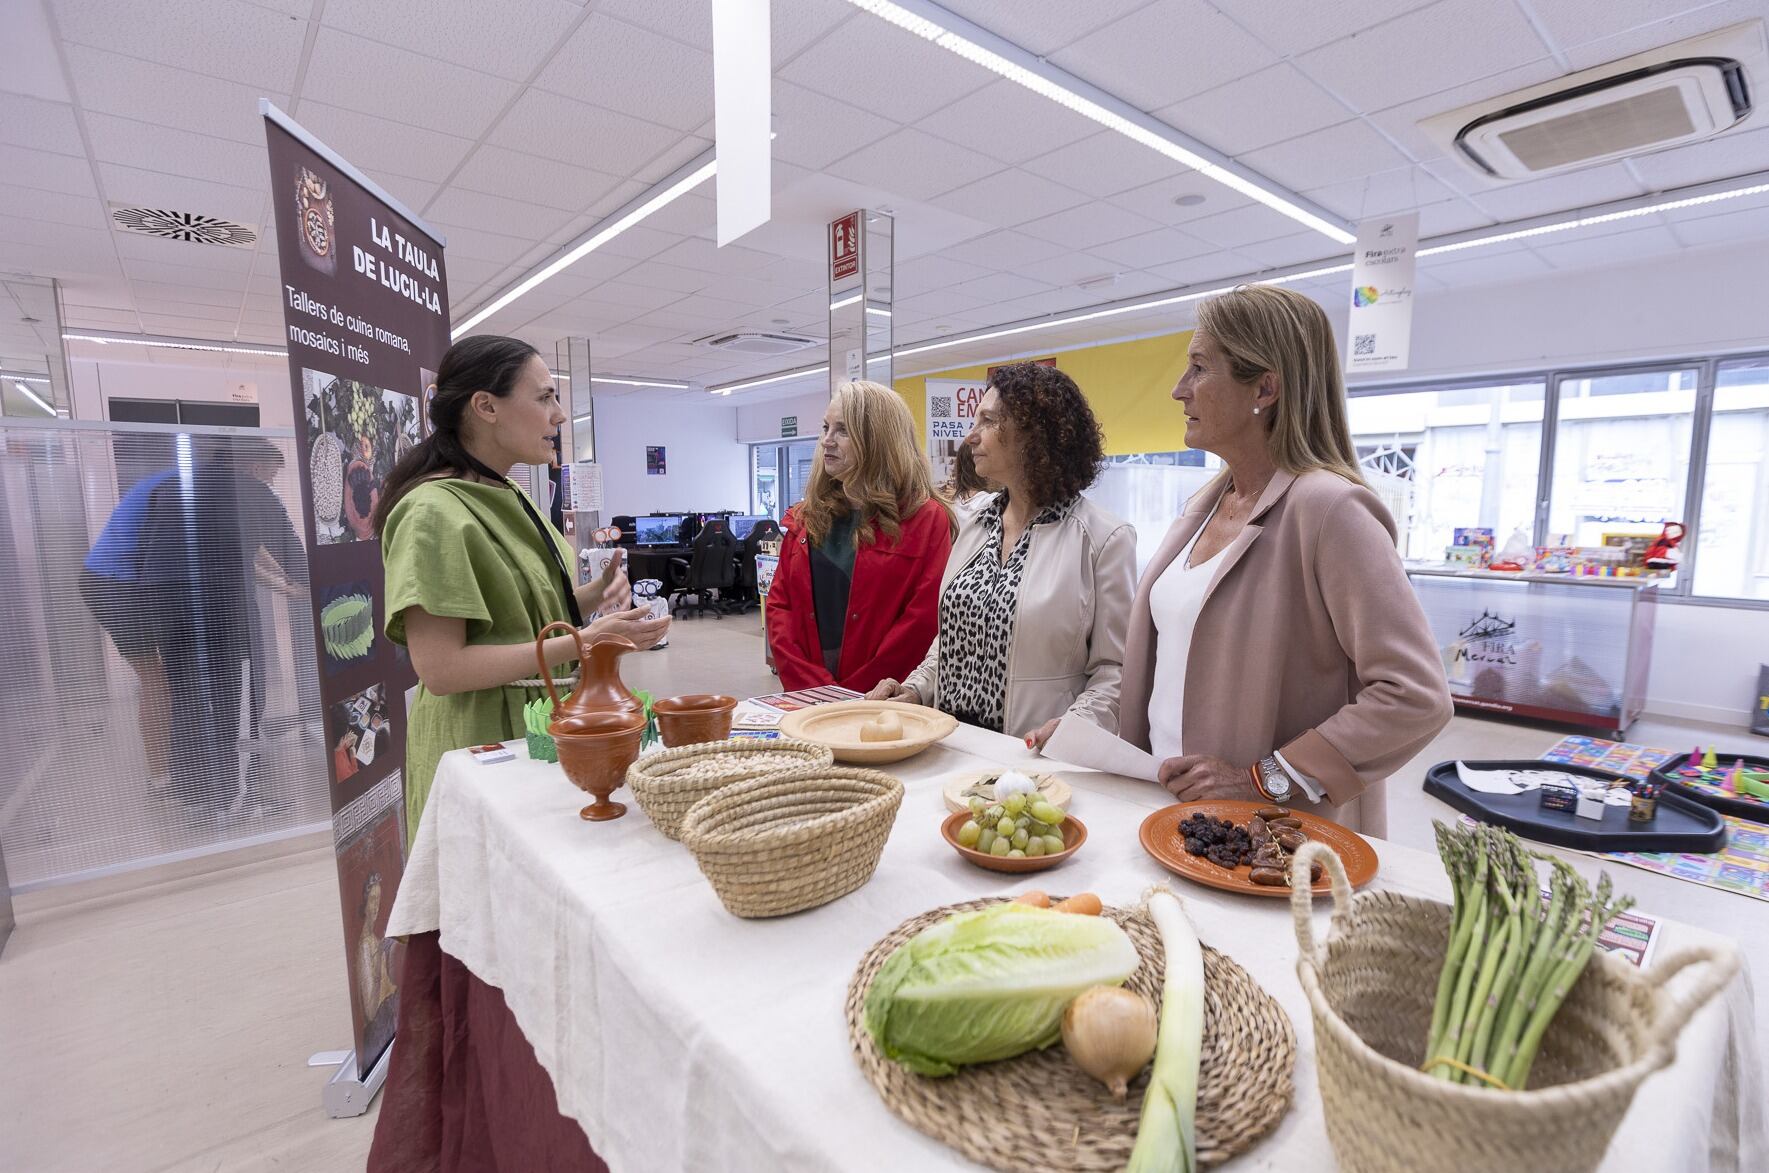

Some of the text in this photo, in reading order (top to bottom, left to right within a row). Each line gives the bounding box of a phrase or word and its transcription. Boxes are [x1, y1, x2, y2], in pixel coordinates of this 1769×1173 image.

[353, 245, 377, 280] DE
[371, 217, 440, 282] LA TAULA
[835, 260, 856, 274] EXTINTOR
[286, 285, 411, 355] Tallers de cuina romana,
[290, 325, 339, 355] mosaics
[347, 344, 370, 365] més
[932, 421, 964, 430] PASA
[932, 429, 965, 438] NIVEL
